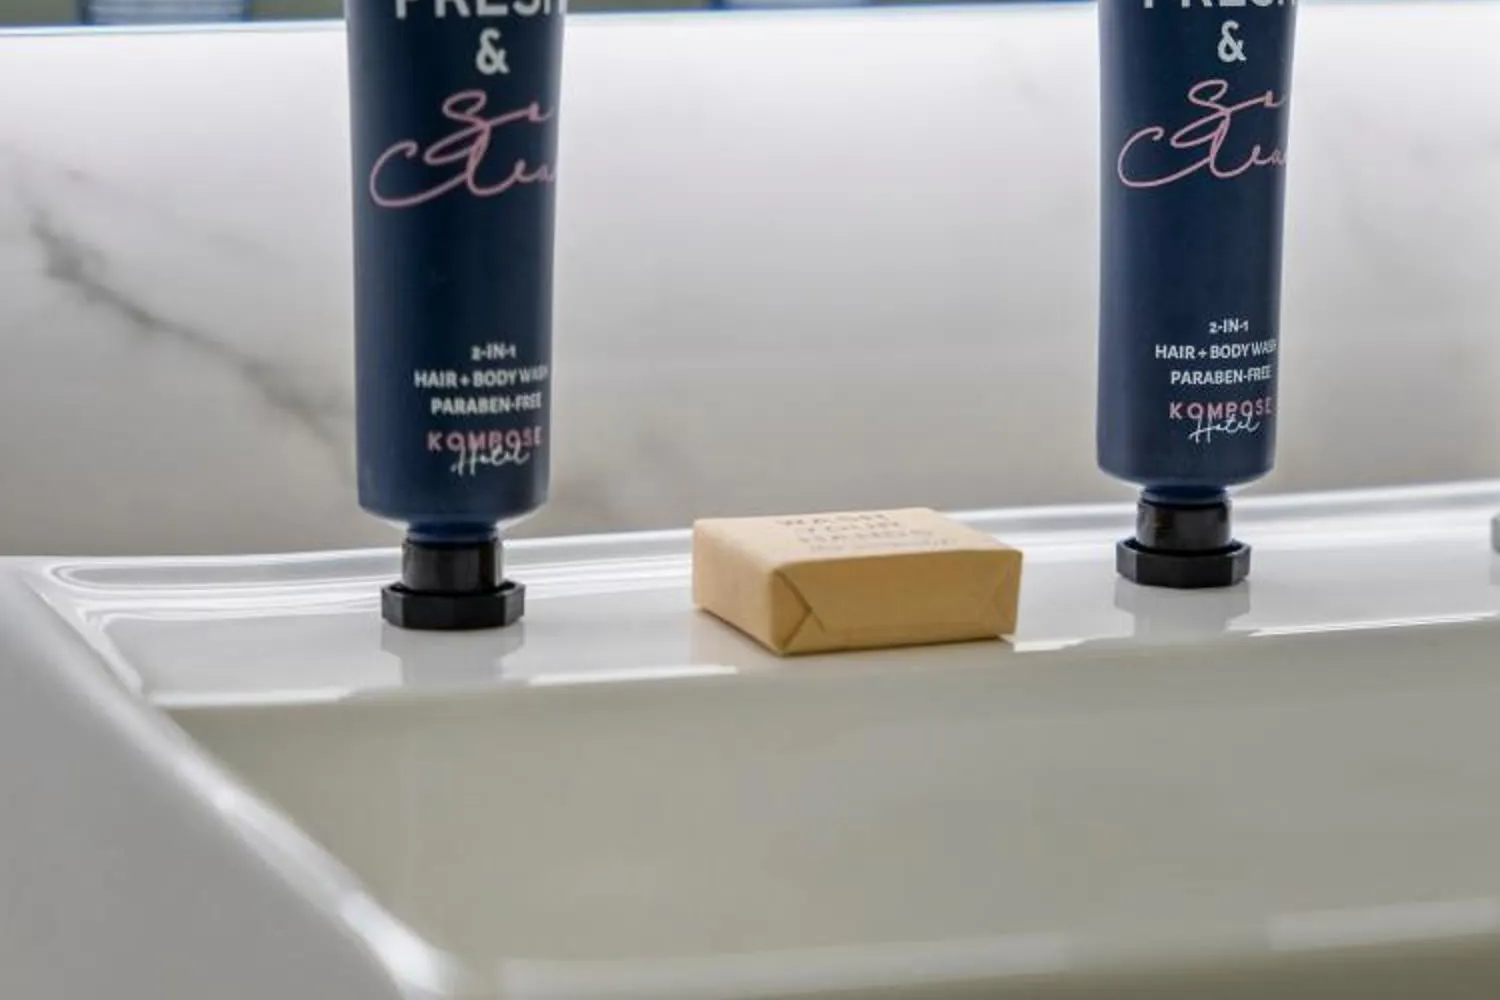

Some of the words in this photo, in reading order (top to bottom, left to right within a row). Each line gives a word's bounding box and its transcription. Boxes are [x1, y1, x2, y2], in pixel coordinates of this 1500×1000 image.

[475, 28, 509, 75] &
[1217, 20, 1247, 63] &
[1208, 318, 1249, 334] 2-IN-1
[1155, 344, 1195, 359] HAIR
[1198, 349, 1208, 358] +
[1210, 343, 1250, 359] BODY
[413, 369, 458, 388] HAIR
[472, 368, 516, 387] BODY
[1170, 365, 1273, 385] PARABEN-FREE
[431, 391, 542, 415] PARABEN-FREE
[1169, 397, 1273, 419] KOMPOSE
[426, 426, 542, 451] KOMPOSE
